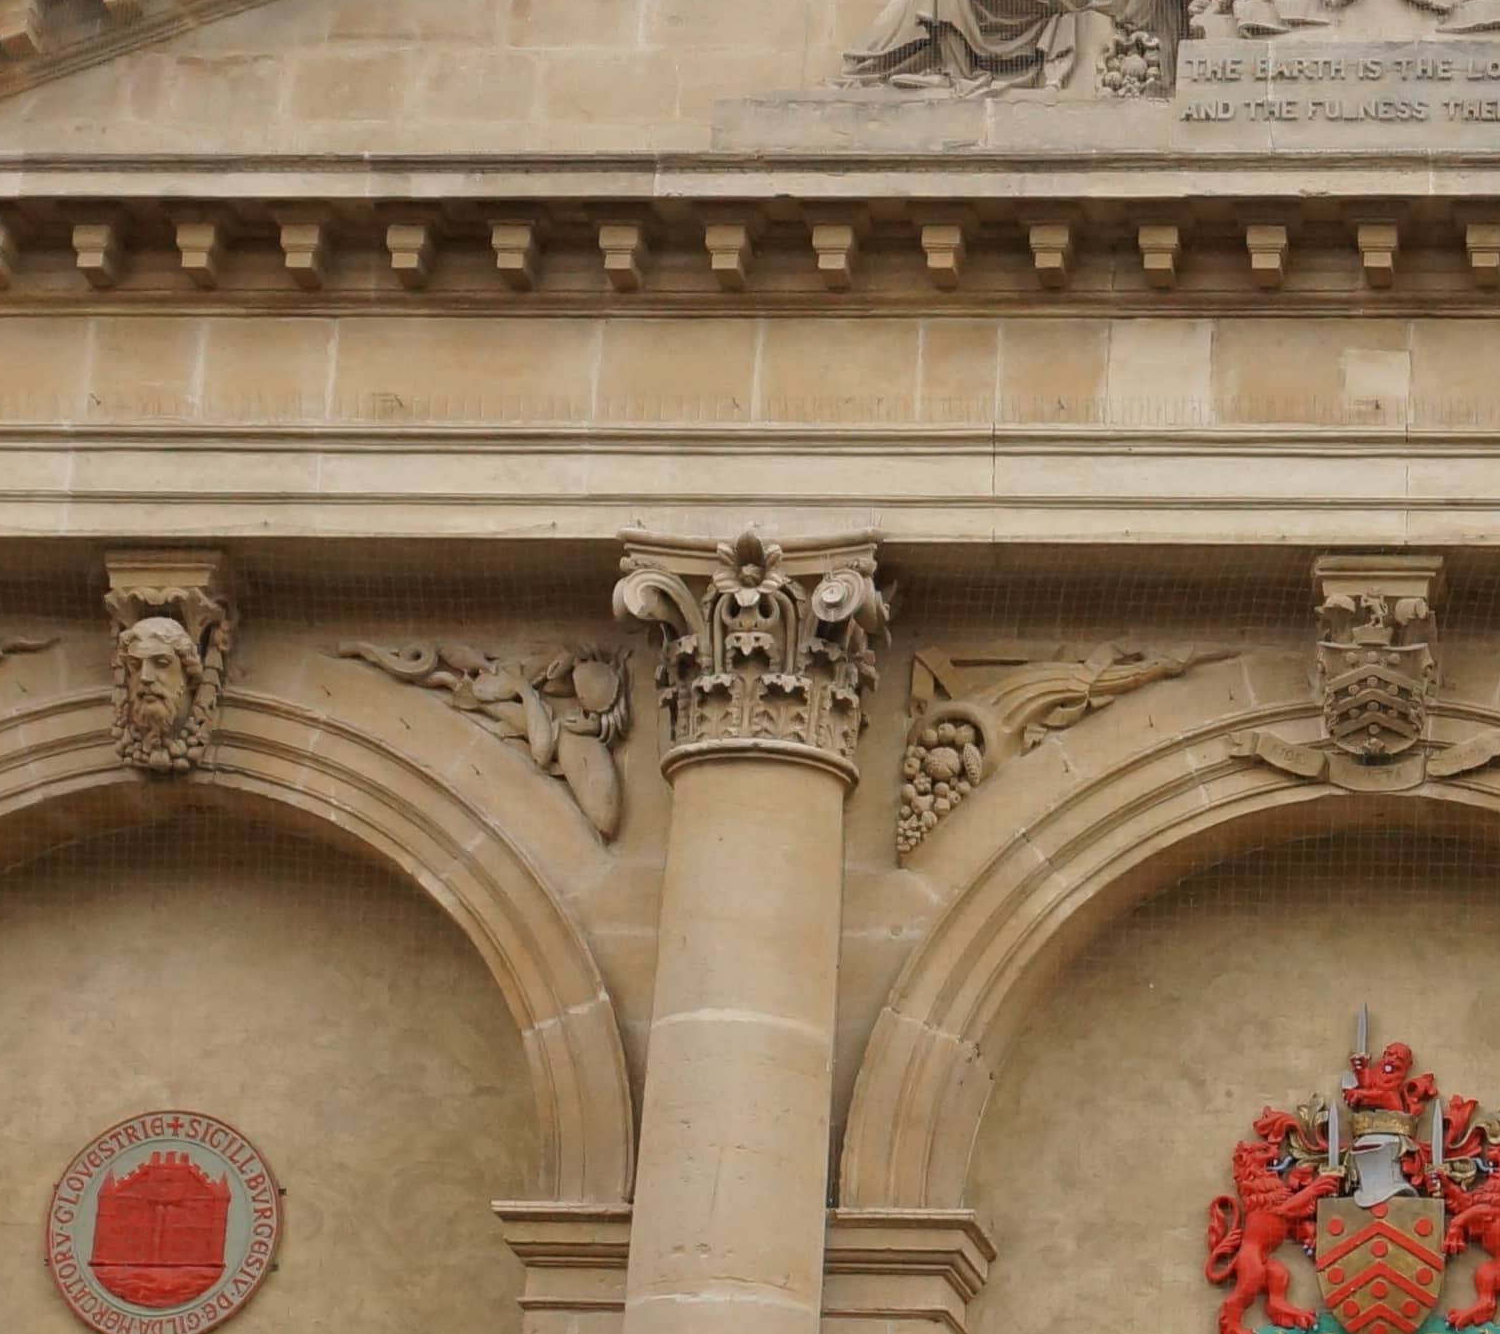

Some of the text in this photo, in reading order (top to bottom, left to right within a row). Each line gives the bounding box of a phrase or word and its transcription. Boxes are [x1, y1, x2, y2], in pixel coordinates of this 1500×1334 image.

[1186, 58, 1243, 82] THE
[1253, 58, 1348, 82] EARTH
[1357, 58, 1384, 81] IS
[1395, 58, 1453, 82] THE
[1179, 100, 1235, 122] AND
[1244, 100, 1299, 122] THE
[1307, 100, 1430, 122] FULNESS
